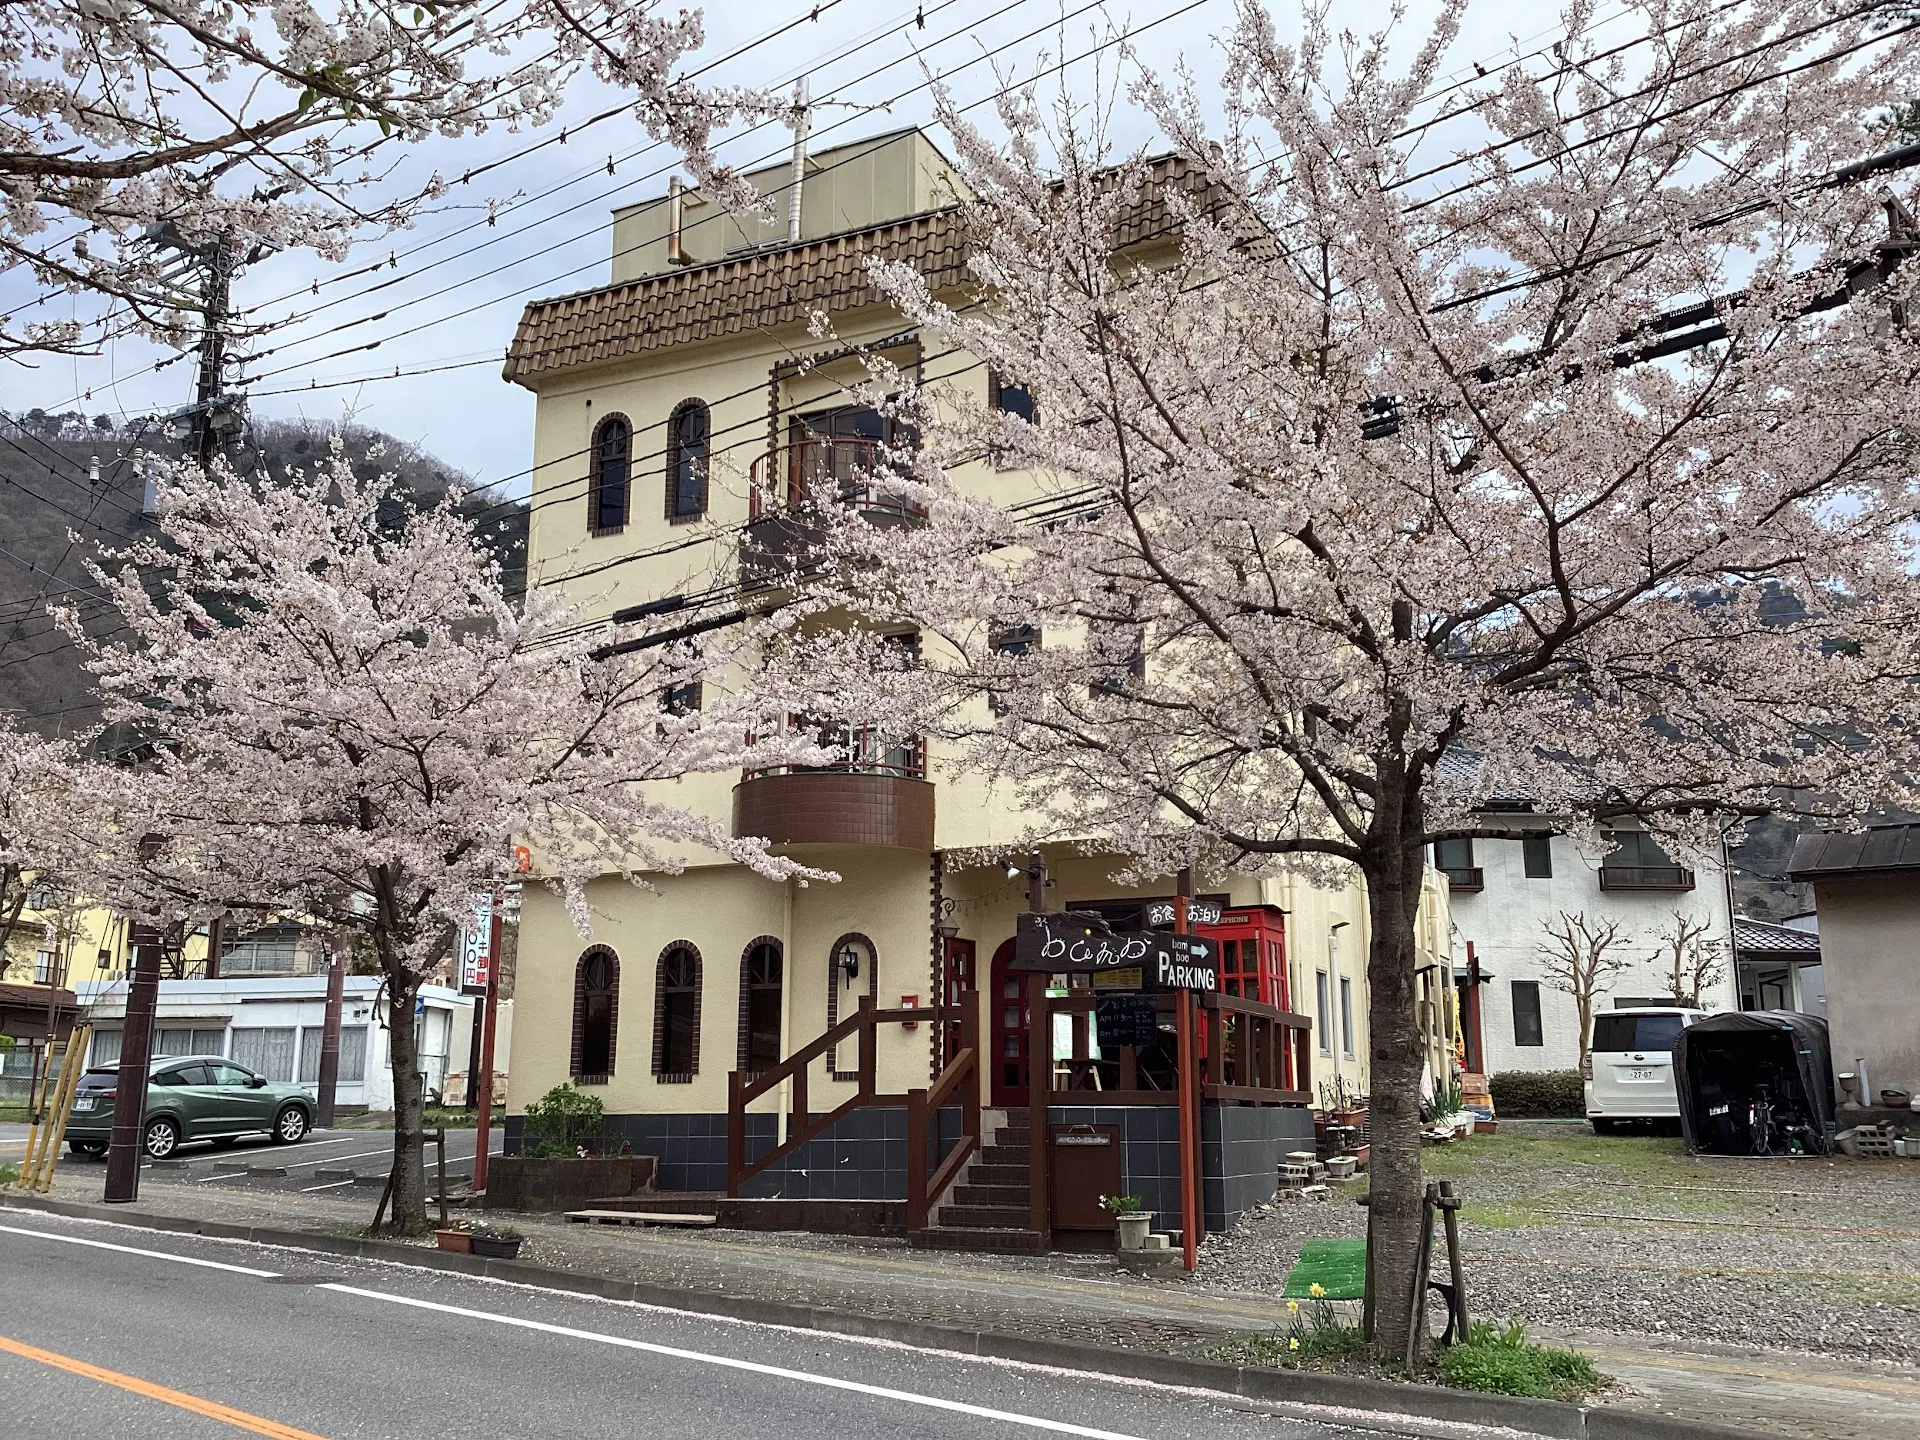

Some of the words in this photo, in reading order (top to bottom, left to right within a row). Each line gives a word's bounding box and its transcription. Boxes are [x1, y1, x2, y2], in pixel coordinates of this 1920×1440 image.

[1150, 904, 1176, 923] お食
[1187, 904, 1221, 924] お泊り
[1219, 915, 1249, 924] EPHONE
[1171, 938, 1189, 950] bam
[1175, 951, 1190, 963] boo
[1158, 951, 1215, 990] PARKING
